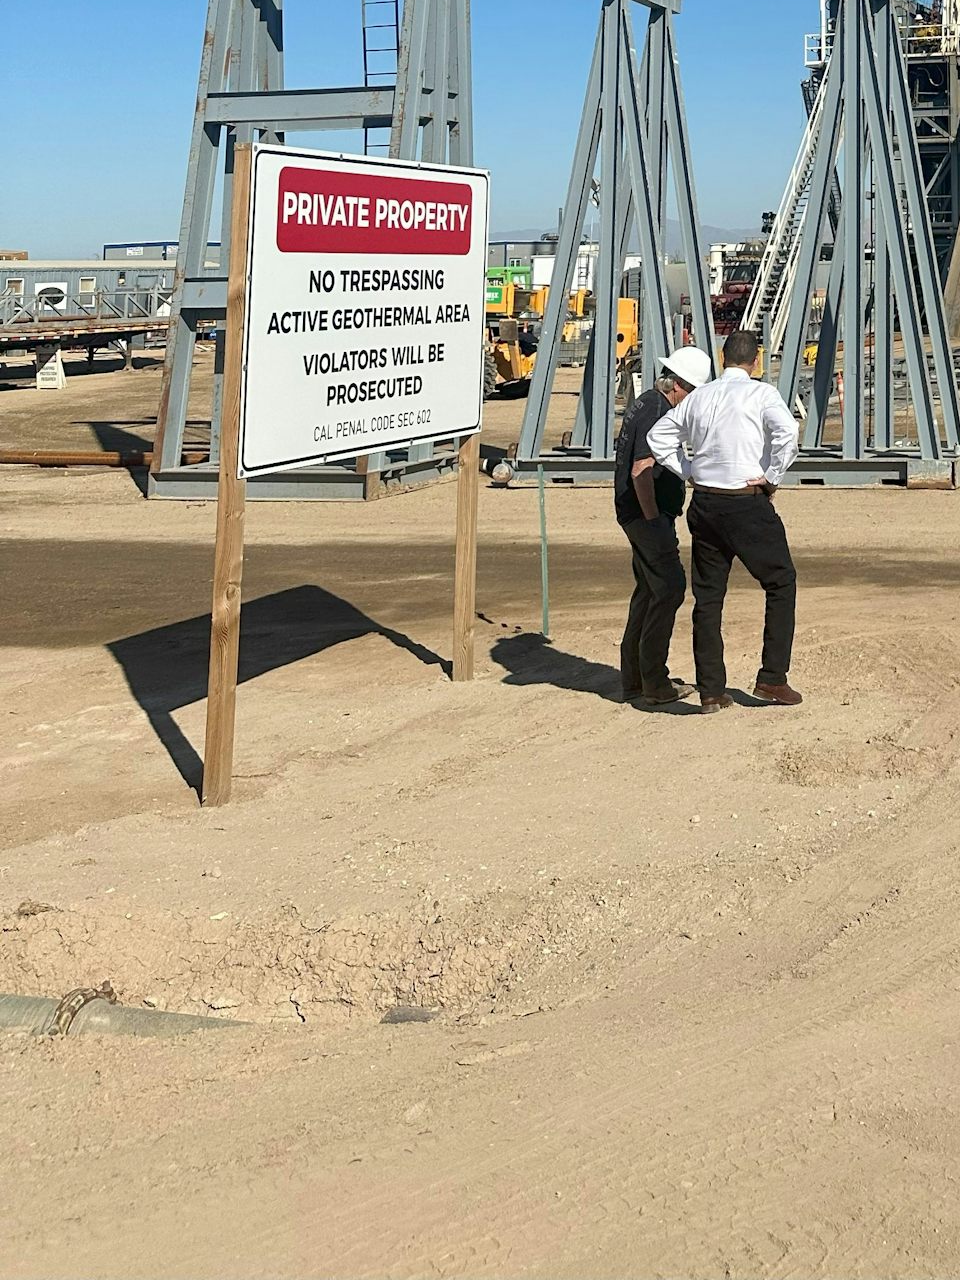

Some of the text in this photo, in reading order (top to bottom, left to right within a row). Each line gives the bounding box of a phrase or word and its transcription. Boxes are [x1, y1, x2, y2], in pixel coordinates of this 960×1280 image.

[282, 191, 469, 232] PRIVATE PROPERTY
[308, 269, 445, 294] NO TRESPASSING
[266, 303, 471, 335] ACTIVE GEOTHERMAL AREA
[302, 342, 445, 376] VIOLATORS WILL BE
[326, 375, 423, 407] PROSECUTED
[313, 408, 432, 442] CAL PENAL CODE SEC 602
